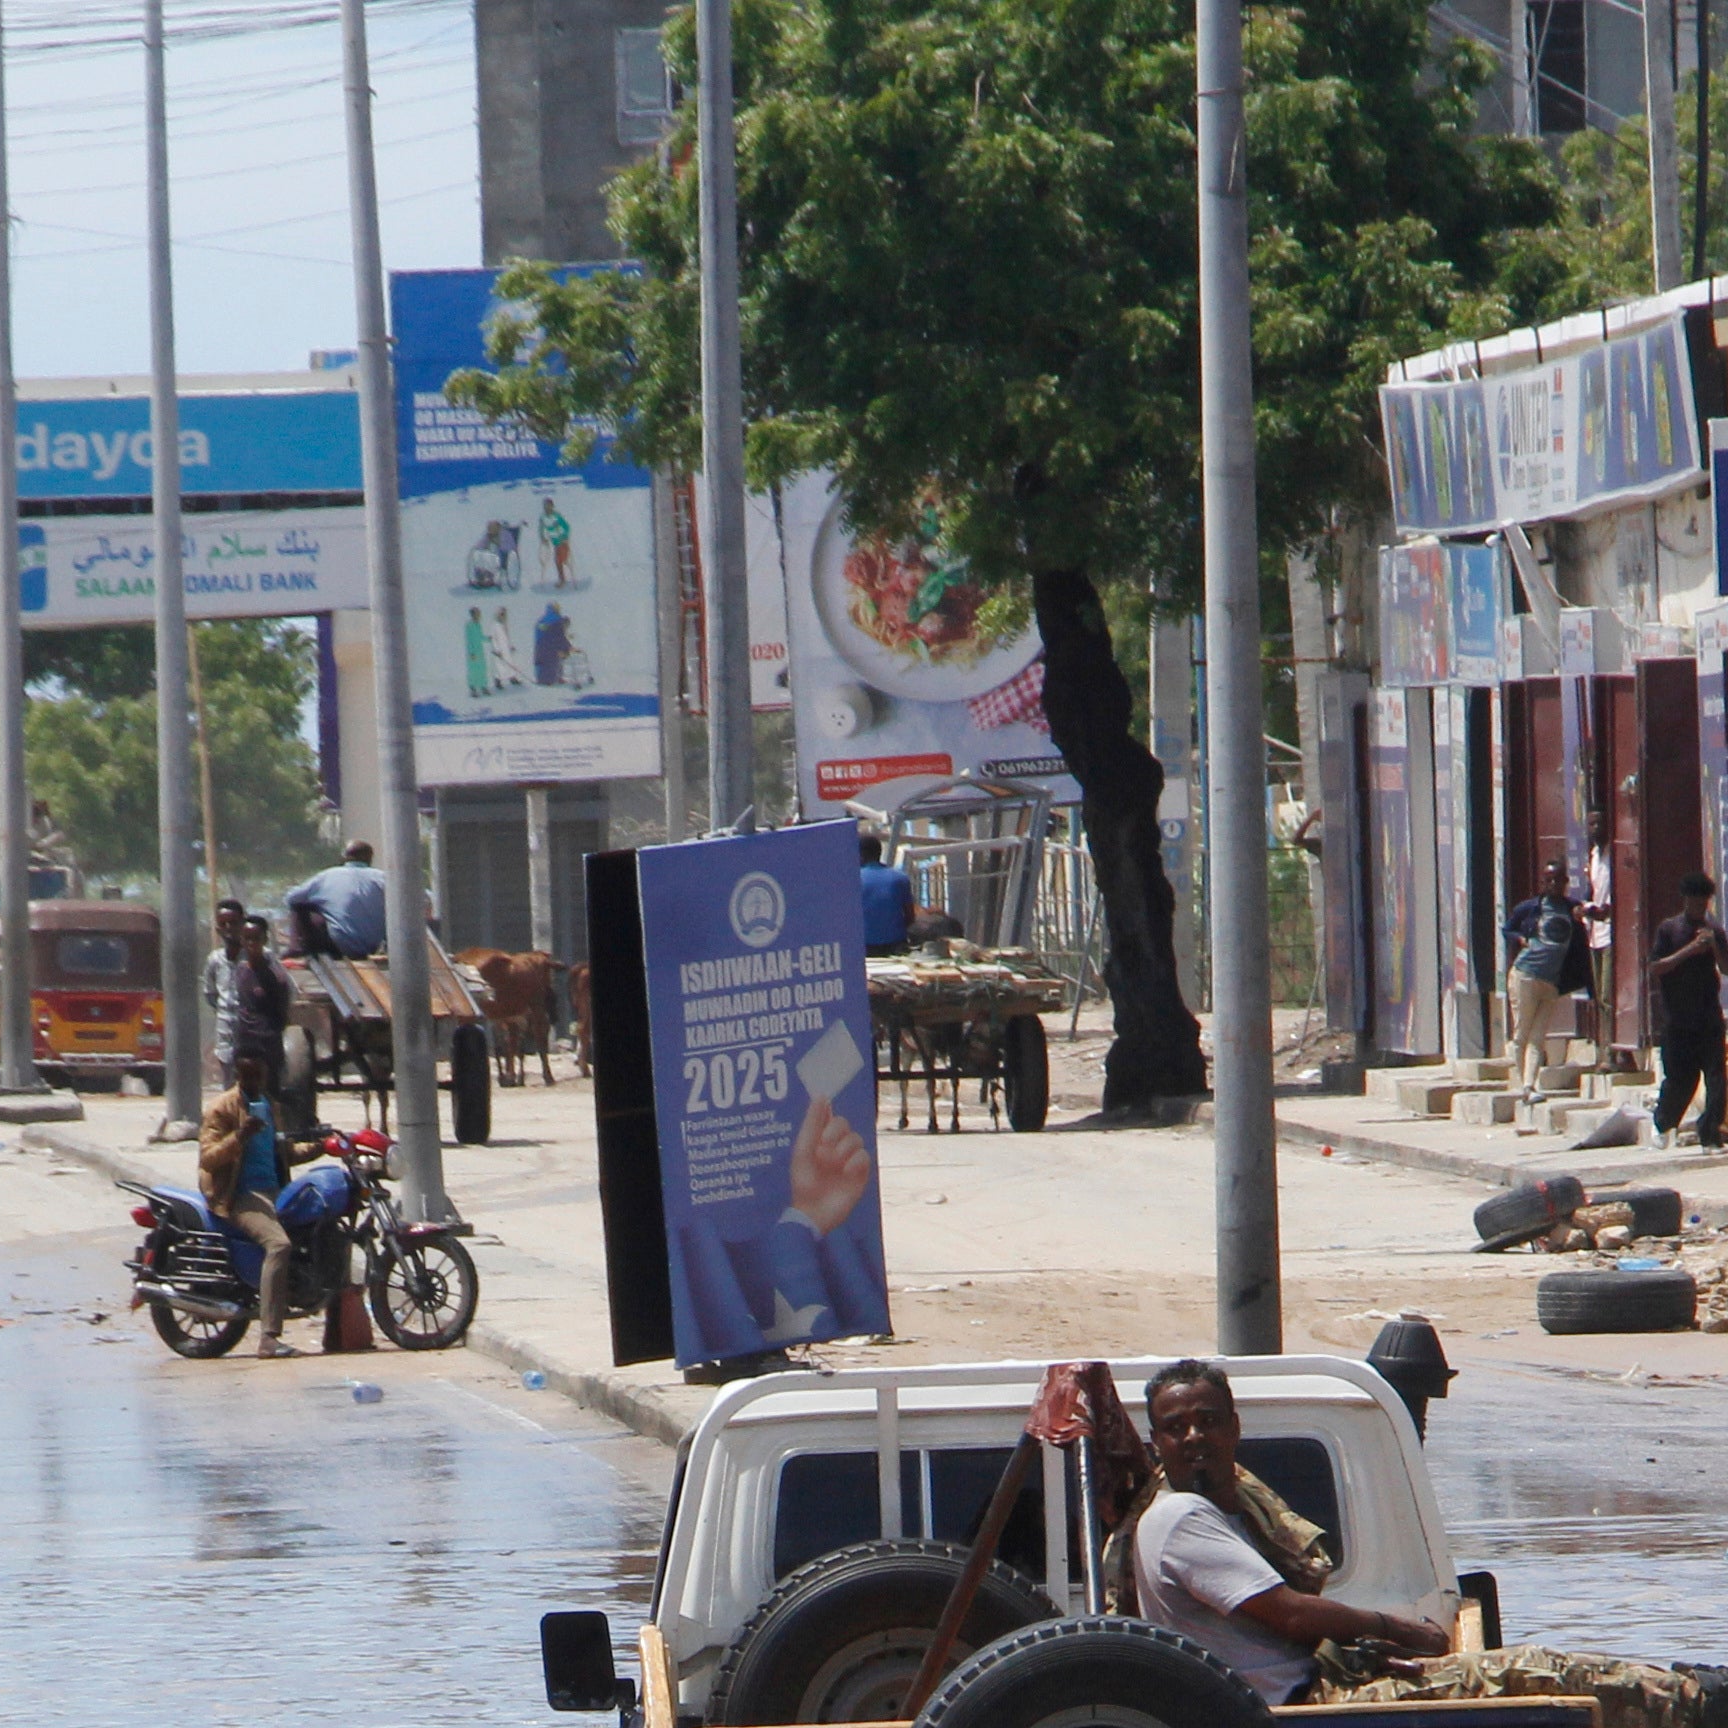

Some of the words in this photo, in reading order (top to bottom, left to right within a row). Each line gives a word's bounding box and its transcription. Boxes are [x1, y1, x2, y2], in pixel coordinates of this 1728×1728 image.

[183, 573, 252, 594] OMALI
[260, 571, 318, 592] BANK
[772, 985, 792, 1010] OO
[685, 1020, 747, 1049] KAARKA
[683, 1045, 788, 1114] 2025
